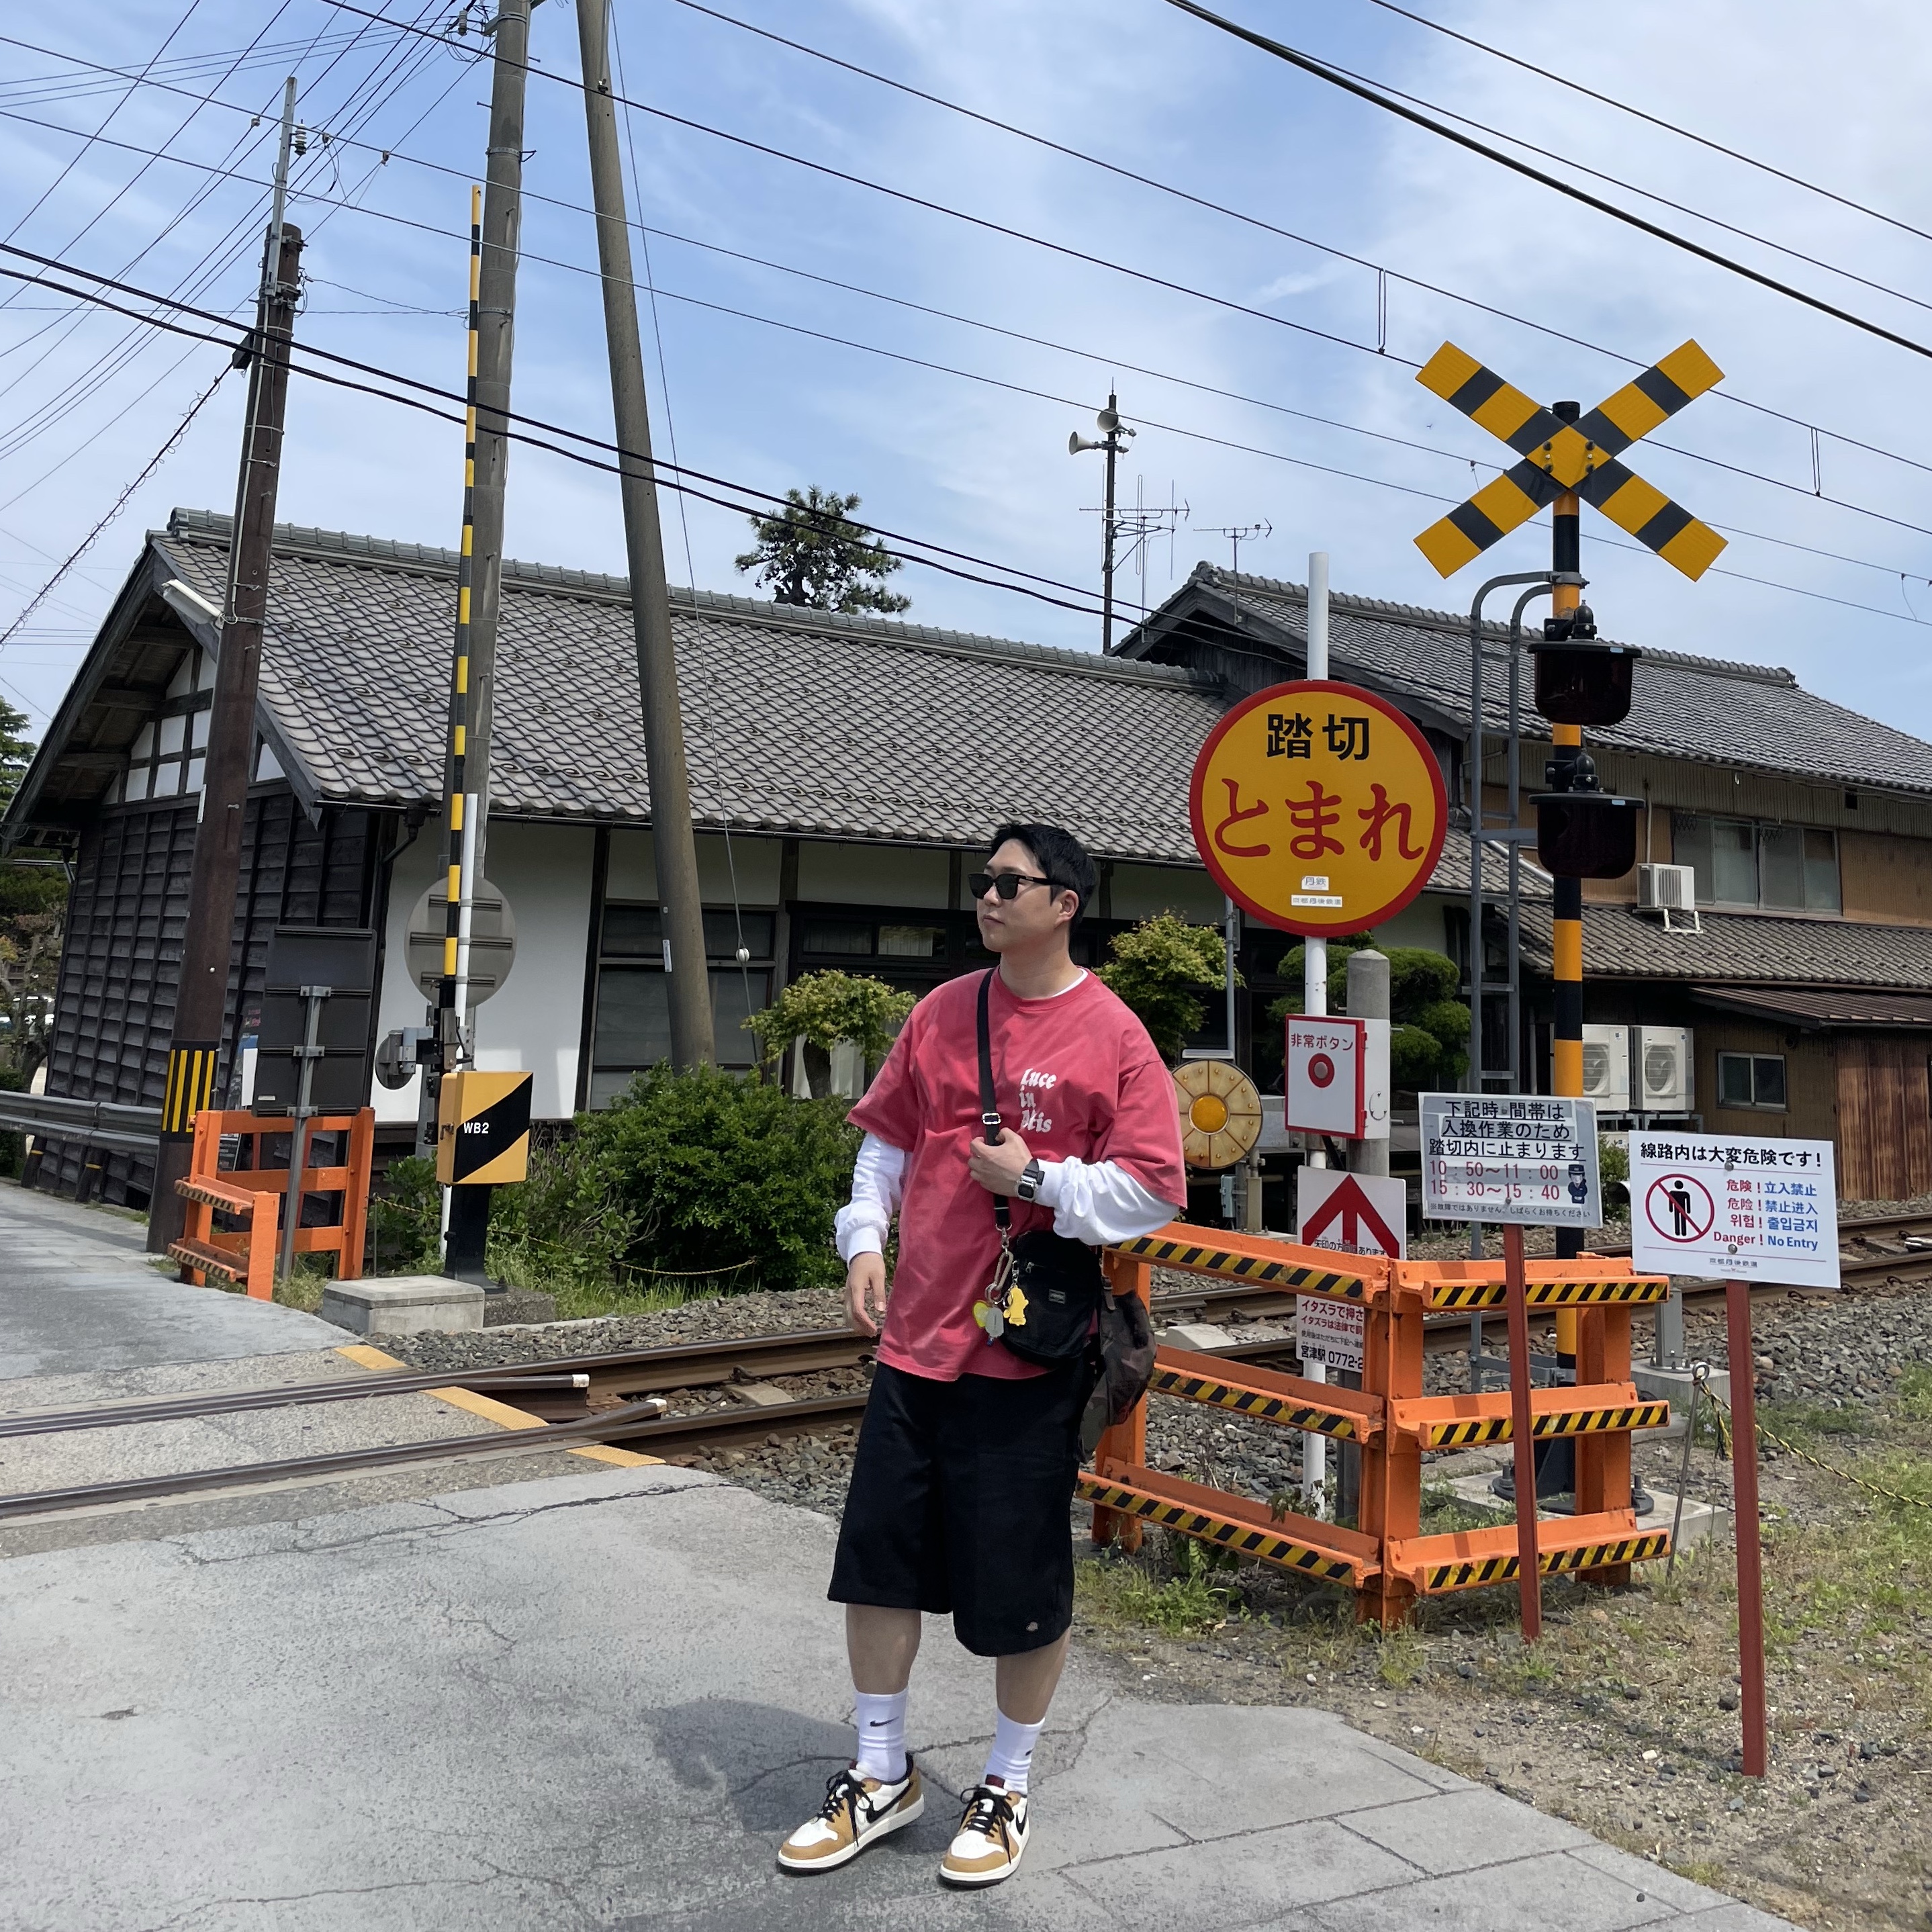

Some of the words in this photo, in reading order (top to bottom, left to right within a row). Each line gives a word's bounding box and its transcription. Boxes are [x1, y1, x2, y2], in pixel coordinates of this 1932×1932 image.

[1267, 712, 1369, 761] 踏切
[1215, 778, 1424, 861] とまれ
[1291, 1033, 1353, 1051] 非常ボタン
[1021, 1068, 1057, 1089] Luce
[463, 1122, 489, 1134] WB2
[1442, 1120, 1569, 1139] 入換作業のため
[1429, 1139, 1584, 1160] 踏切内に止まります
[1641, 1142, 1821, 1167] 線路内は大変危険です！
[1767, 1217, 1818, 1233] 출입금지
[1767, 1235, 1784, 1246] No
[1787, 1237, 1819, 1251] Entry
[1301, 1345, 1326, 1362] 宮津駅
